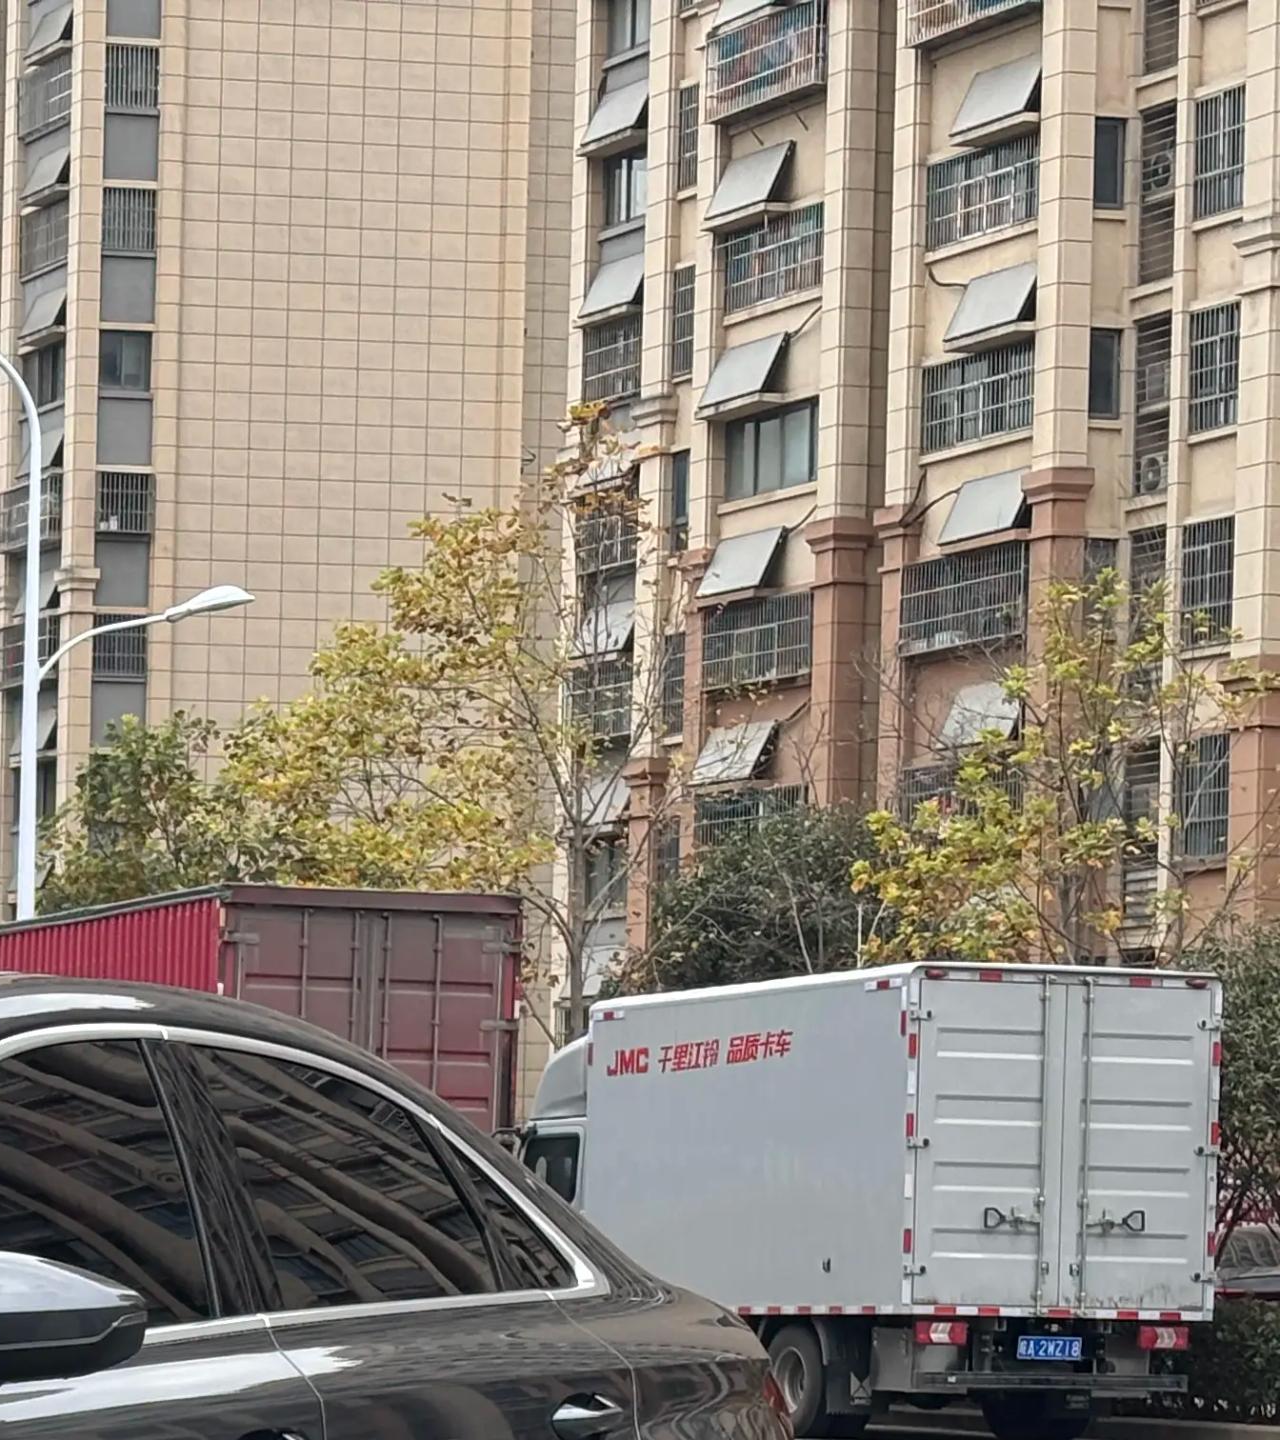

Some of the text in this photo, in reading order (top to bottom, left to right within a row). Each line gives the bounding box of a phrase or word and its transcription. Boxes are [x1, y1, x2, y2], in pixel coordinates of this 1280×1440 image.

[607, 1029, 794, 1077] JMC 千里江铃 品质卡车
